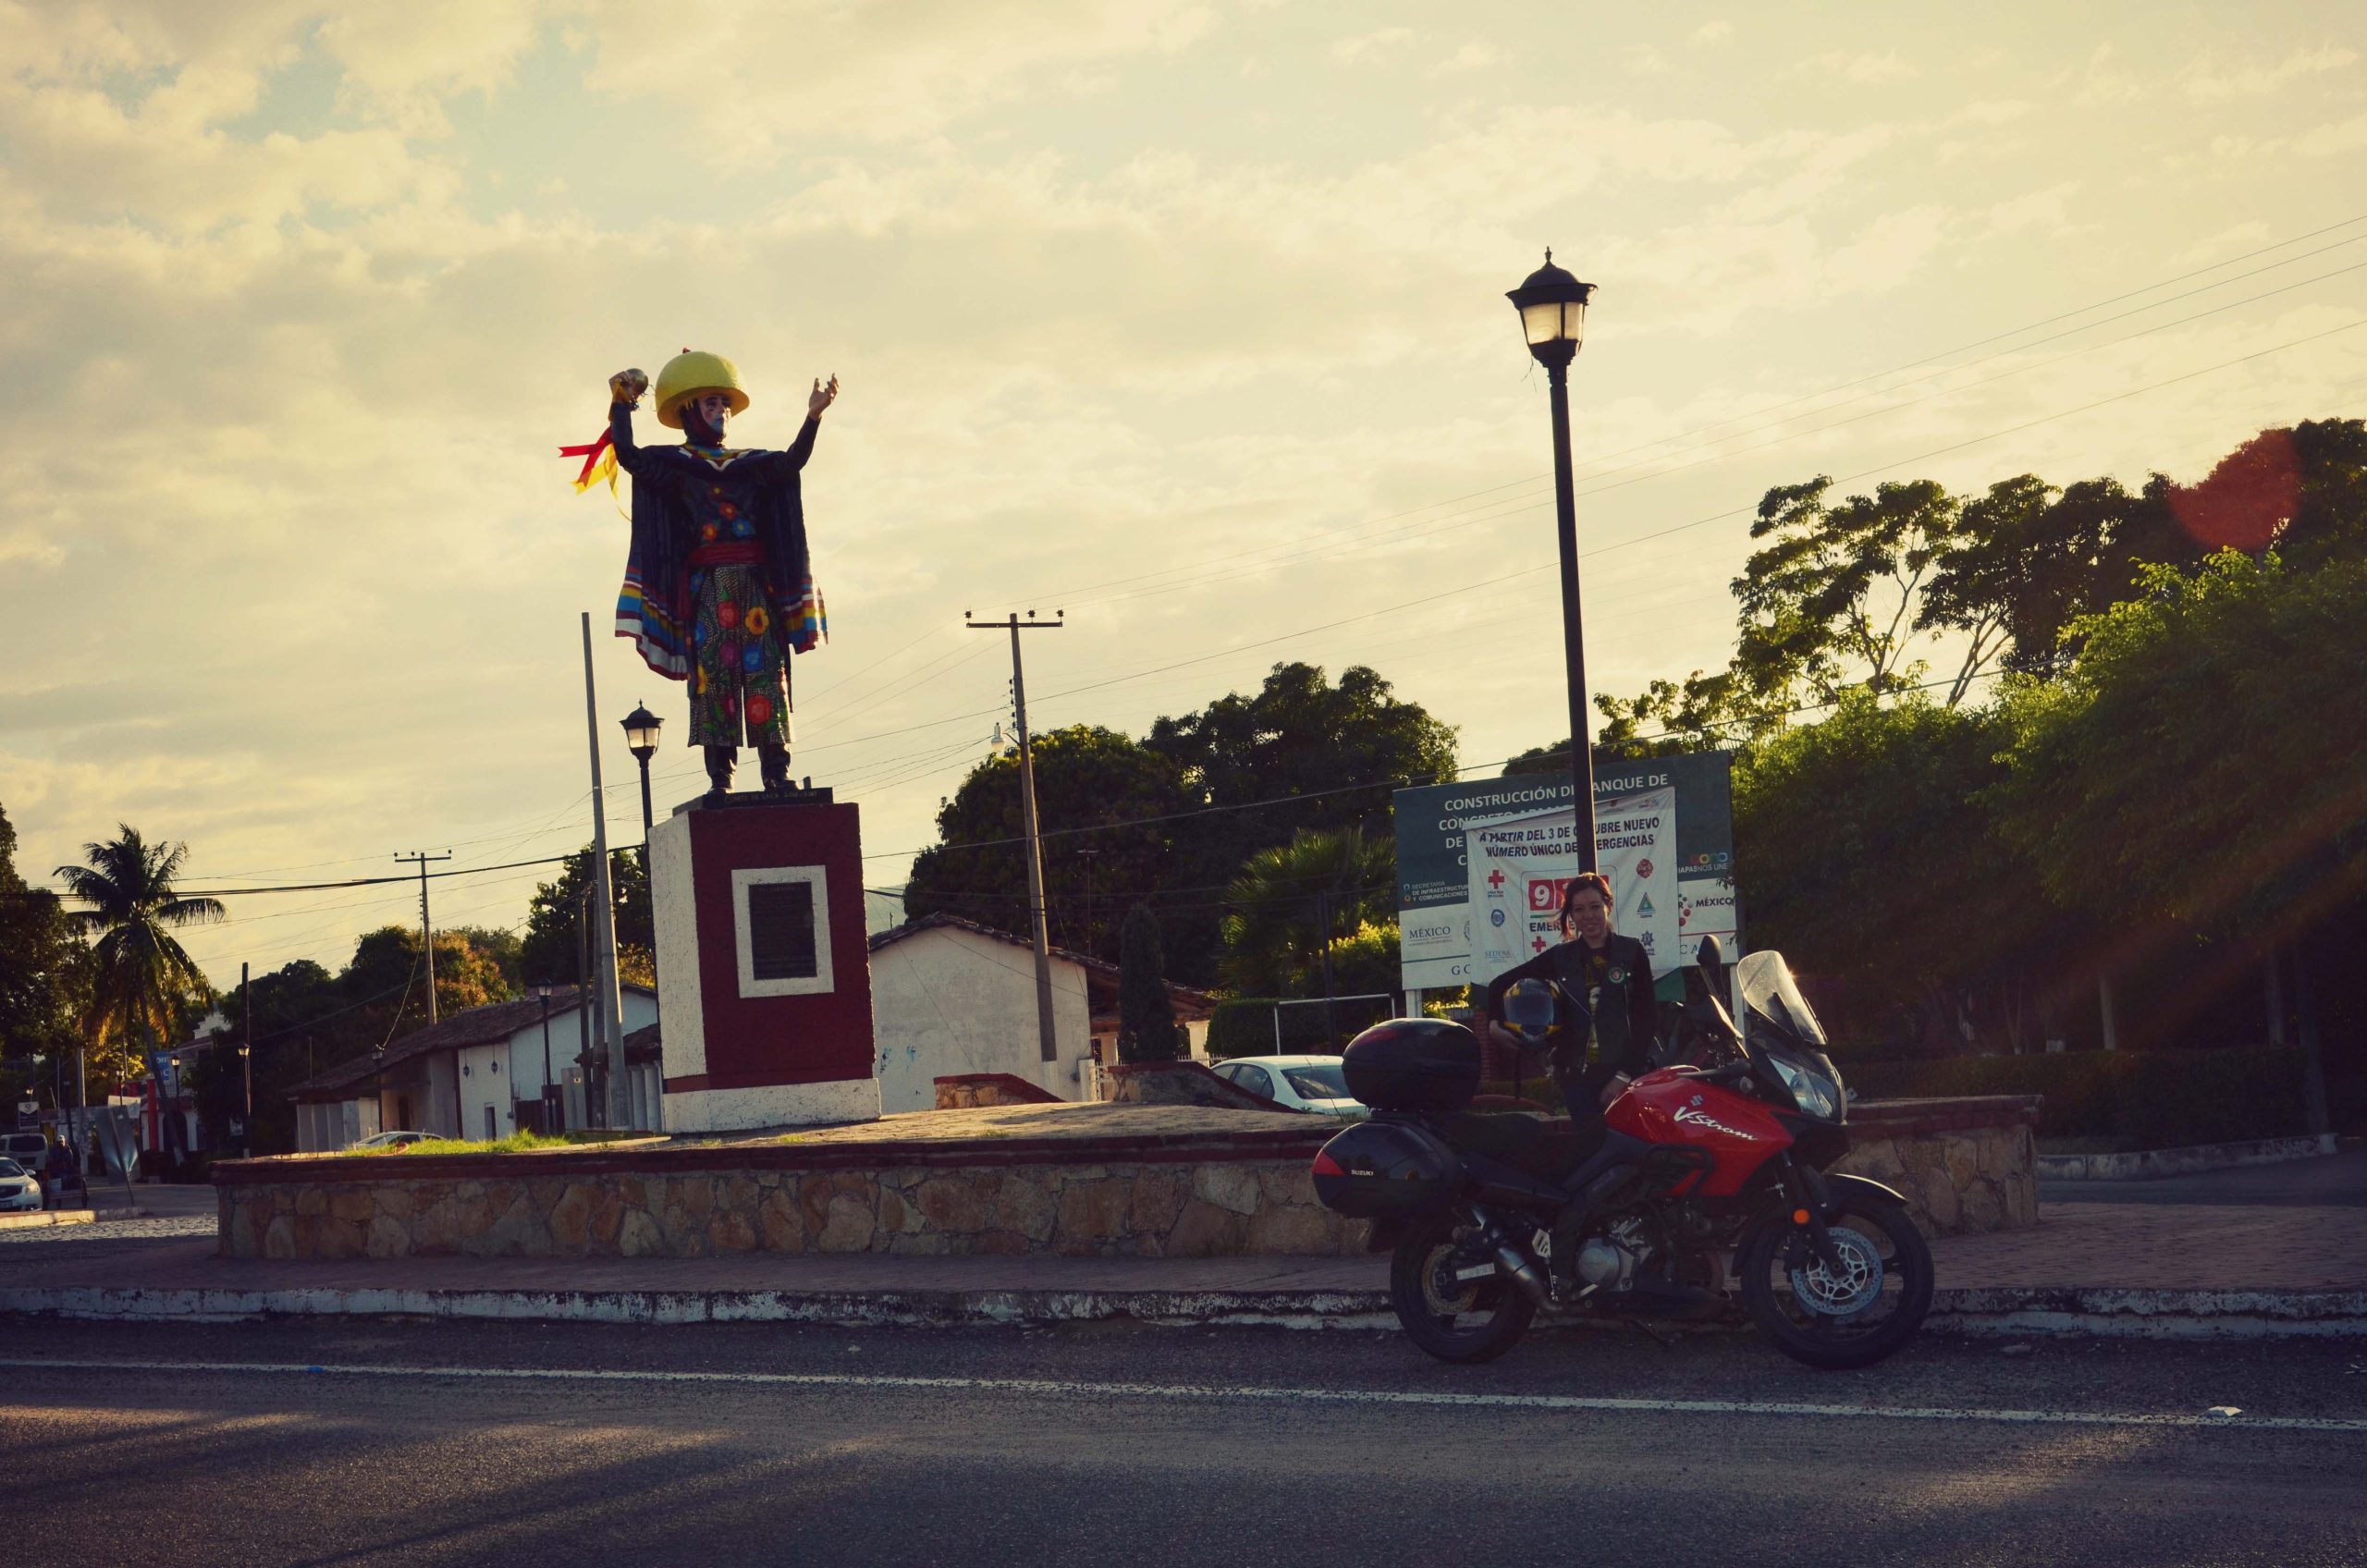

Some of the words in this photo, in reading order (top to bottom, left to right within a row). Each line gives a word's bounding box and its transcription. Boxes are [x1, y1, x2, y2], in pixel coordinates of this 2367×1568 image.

[1444, 786, 1556, 812] CONSTRUCCIÓN
[1561, 784, 1575, 797] D
[1592, 777, 1644, 792] ANQUE
[1649, 774, 1668, 787] DE
[1479, 832, 1487, 842] A
[1490, 831, 1525, 843] PARTIR
[1527, 829, 1546, 840] DEL
[1549, 827, 1554, 839] 3
[1557, 827, 1570, 839] DE
[1624, 817, 1660, 832] NUEVO
[1445, 836, 1464, 849] DE
[1486, 845, 1528, 857] NÚMERO
[1530, 842, 1562, 856] ÚNICO
[1565, 841, 1577, 853] DE
[1597, 834, 1654, 851] ERGENCIAS
[1696, 897, 1732, 908] MÉXICO
[1409, 925, 1451, 938] MÉXICO
